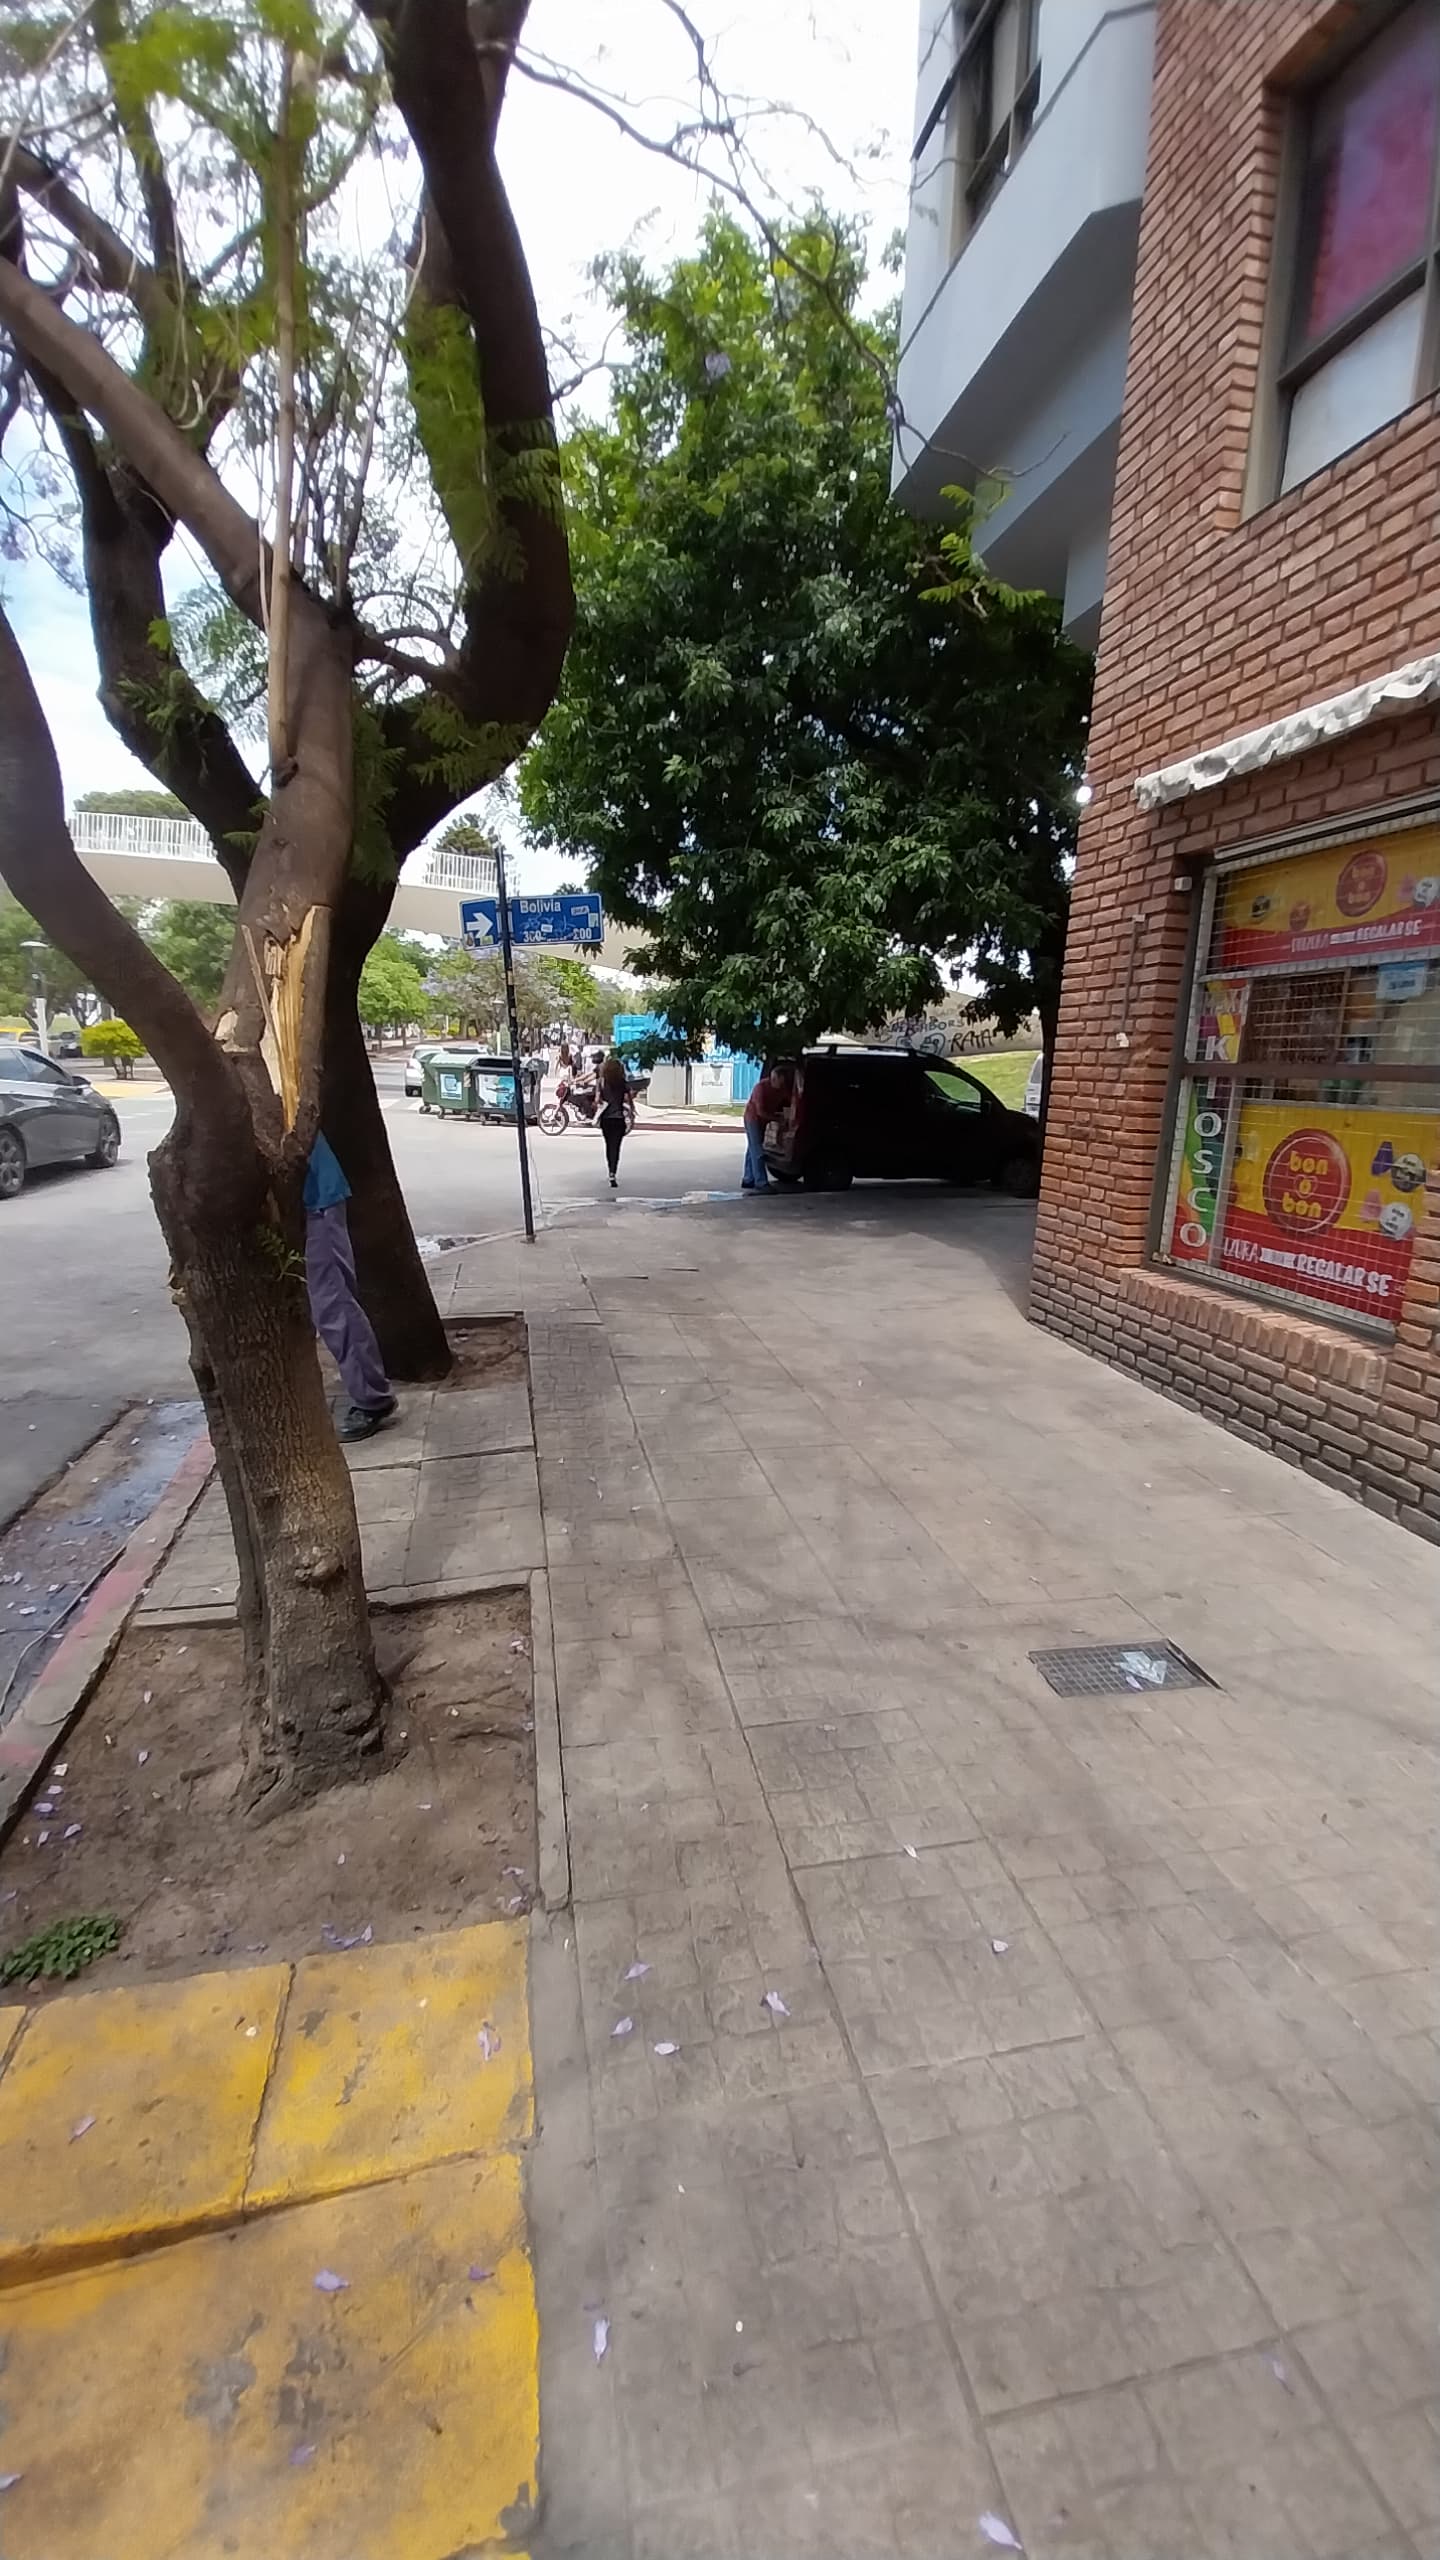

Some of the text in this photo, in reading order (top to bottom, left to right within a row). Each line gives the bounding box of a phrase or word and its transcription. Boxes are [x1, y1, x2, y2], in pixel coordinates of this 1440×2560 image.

[520, 899, 562, 914] Bolivia
[573, 927, 592, 940] 200
[1289, 1151, 1329, 1175] bon
[1300, 1179, 1312, 1195] o
[1282, 1191, 1323, 1218] bon
